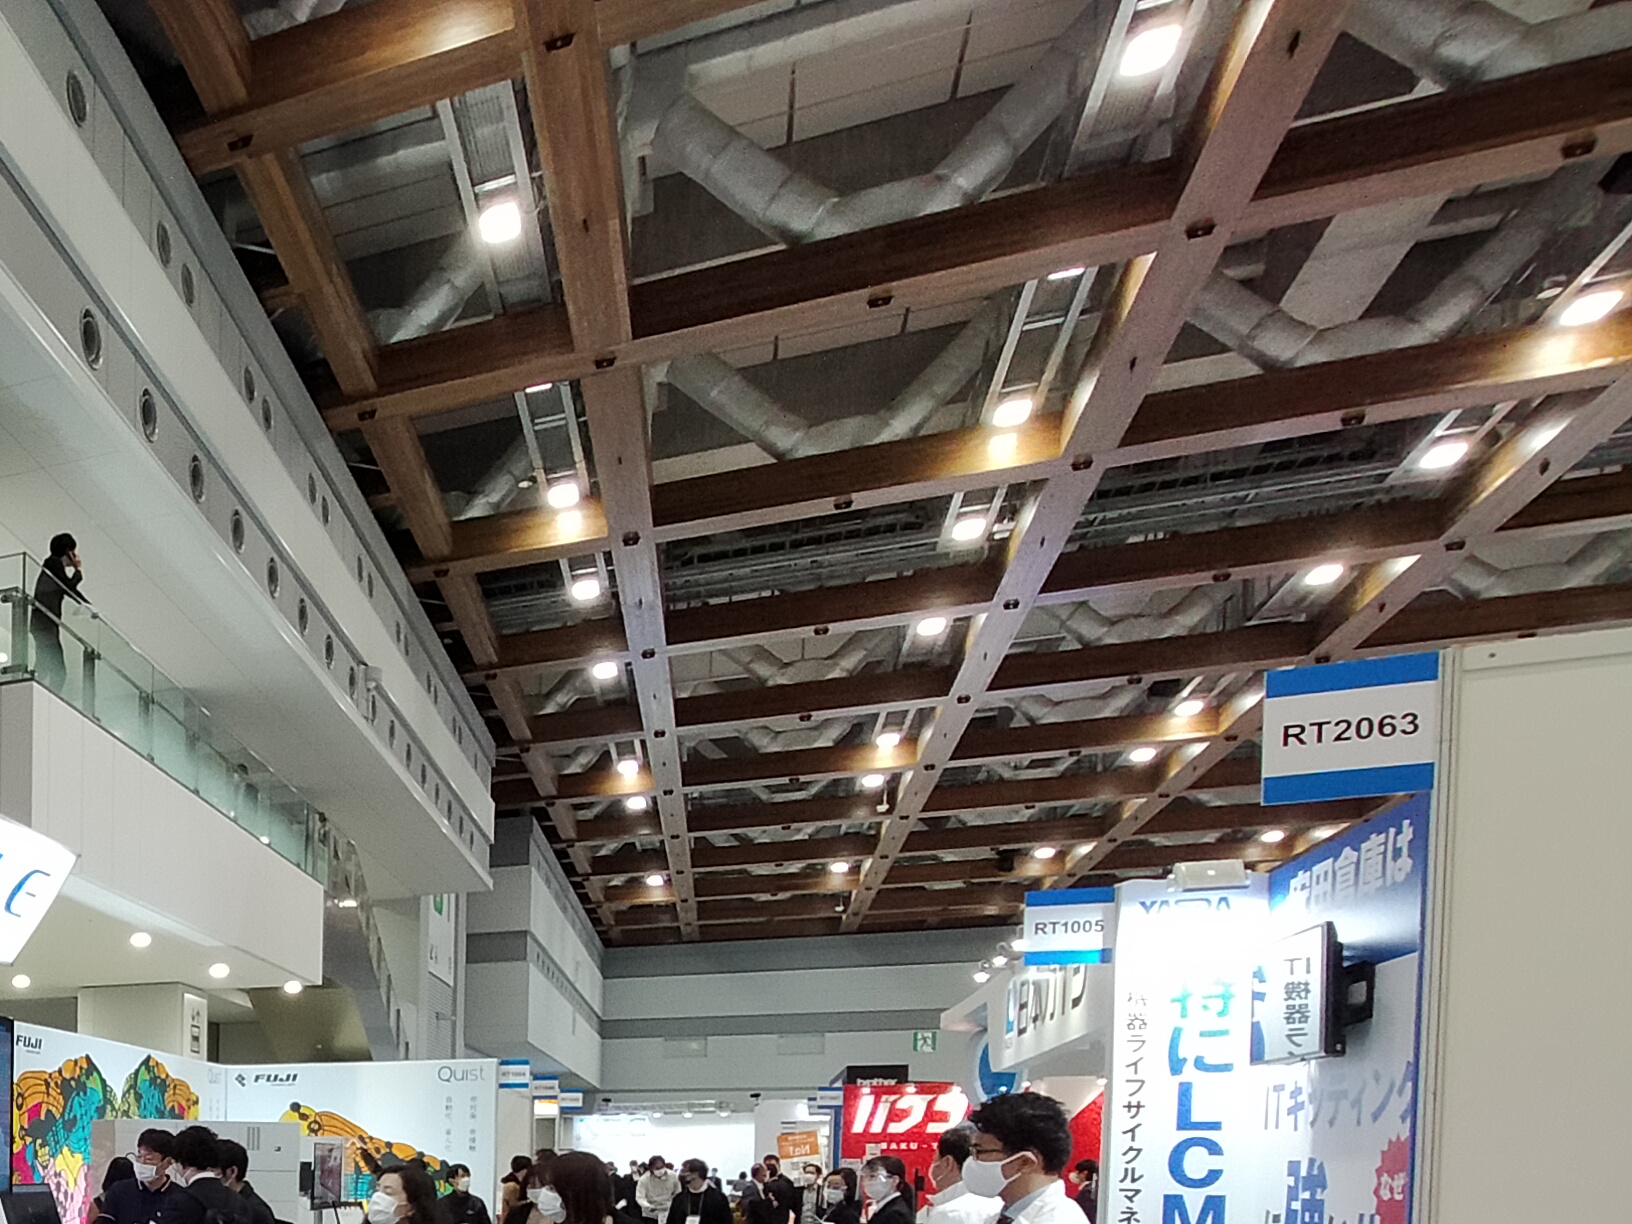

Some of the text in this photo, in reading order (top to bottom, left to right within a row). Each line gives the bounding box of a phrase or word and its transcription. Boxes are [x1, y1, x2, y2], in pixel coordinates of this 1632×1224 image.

[1282, 712, 1420, 748] RT2063
[1033, 918, 1105, 936] RT1005
[16, 1034, 43, 1050] FUJI
[253, 1073, 298, 1083] FUJI
[438, 1065, 486, 1082] Quist
